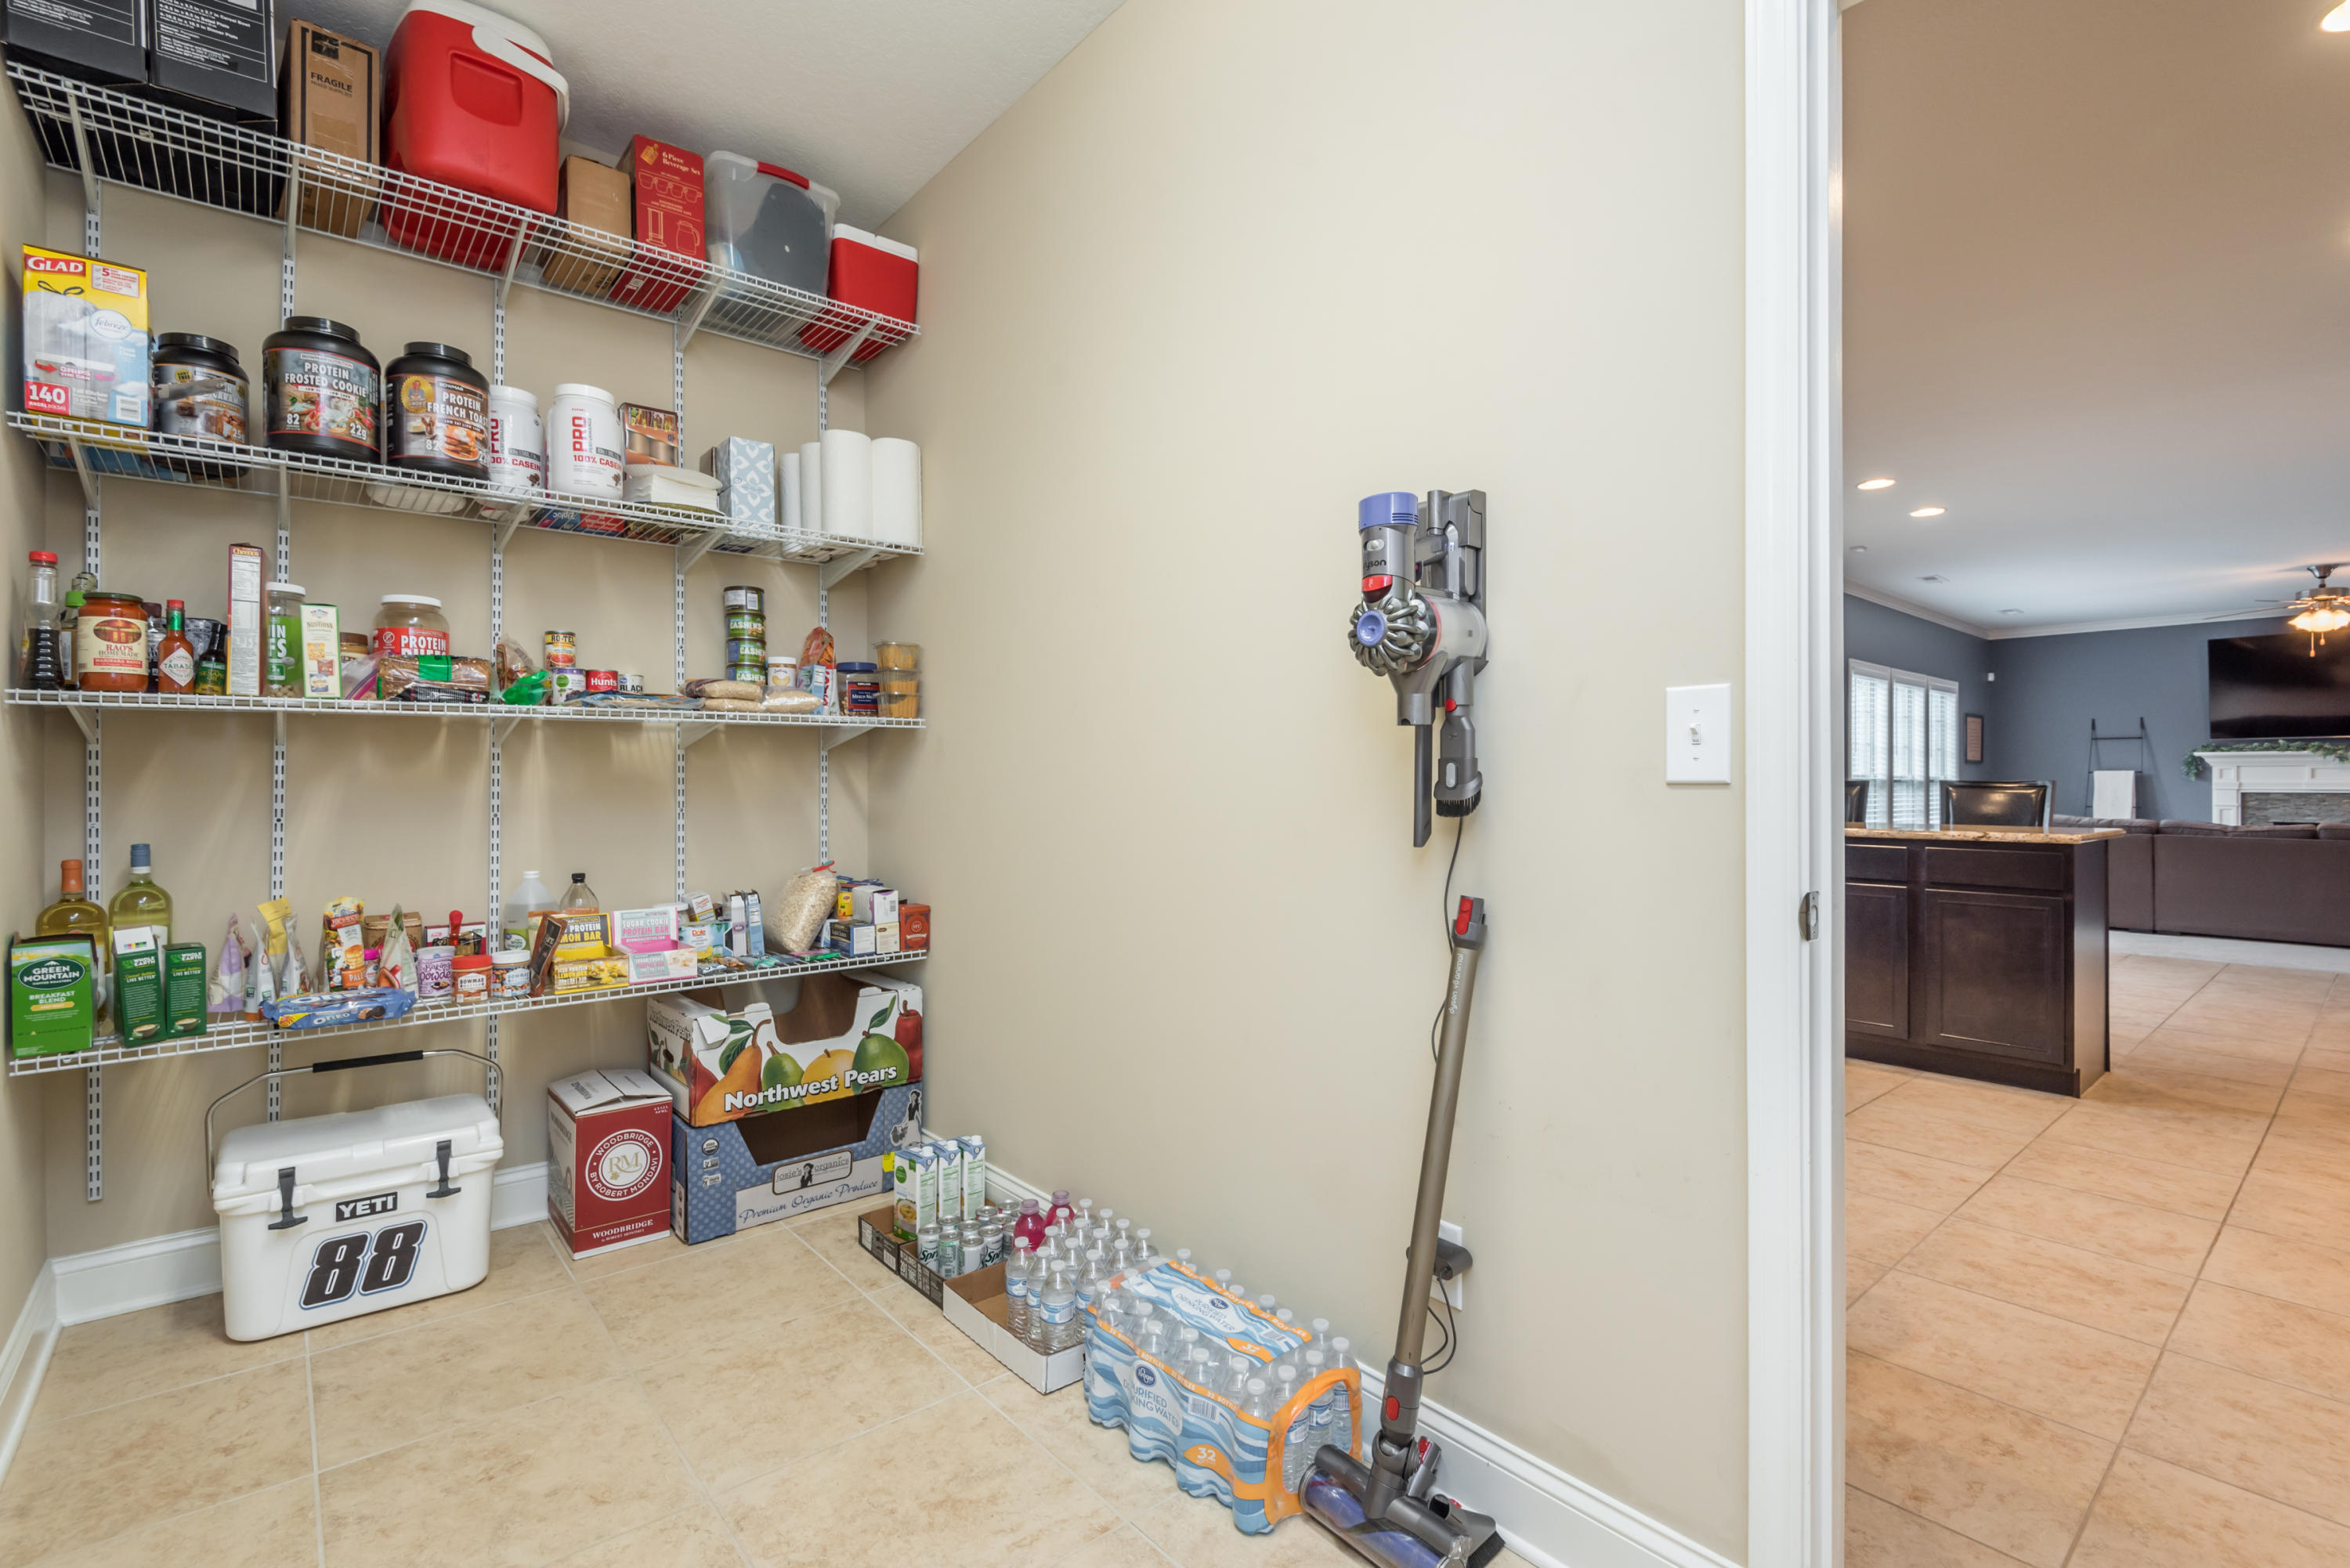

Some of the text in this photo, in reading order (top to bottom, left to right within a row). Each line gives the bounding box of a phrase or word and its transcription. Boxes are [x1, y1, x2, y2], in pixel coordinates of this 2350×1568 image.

[310, 71, 352, 93] FRAGILE
[663, 157, 700, 175] Beverage Set
[668, 154, 684, 164] Piece
[27, 256, 83, 273] GLAD
[101, 268, 110, 276] 5
[95, 316, 128, 331] febreze
[305, 362, 349, 380] PROTEIN
[284, 373, 328, 387] FROSTED
[332, 379, 367, 398] COOKIE
[439, 381, 464, 392] BOWMAR
[29, 385, 67, 404] 140
[443, 392, 481, 411] PROTEIN
[287, 414, 299, 425] 82
[427, 402, 466, 419] FRENCH
[468, 410, 488, 427] TOAST
[349, 423, 367, 440] 22g
[572, 416, 587, 452] PRO
[425, 439, 439, 451] 82
[512, 458, 541, 472] CASEIN
[573, 454, 622, 471] 100% CASEIN
[730, 621, 762, 630] CASHEWS
[107, 644, 133, 652] RAO'S
[401, 635, 446, 651] PROTEIN
[569, 923, 602, 933] PROTEIN
[622, 925, 669, 936] PROTEIN BAR
[623, 917, 668, 928] SUGAR COOKIE
[560, 931, 602, 943] MON BAR
[33, 966, 70, 975] GREEN
[425, 961, 451, 972] Baking
[24, 971, 80, 982] MOUNTAIN
[419, 970, 451, 984] powde
[1448, 991, 1458, 1013] dyson
[1455, 954, 1463, 980] animal
[29, 991, 75, 1000] BREAKFAST
[313, 1012, 350, 1025] OREO
[674, 1019, 691, 1042] Pears
[724, 1066, 897, 1112] Northwest Pears
[595, 1133, 653, 1156] WOODBRIDGE
[608, 1151, 642, 1173] RM
[776, 1156, 850, 1183] josie's organics
[590, 1158, 658, 1197] BY ROBERT MONDAVI
[338, 1195, 396, 1218] YETI
[739, 1180, 878, 1223] Premium Organic Produce
[592, 1219, 653, 1239] WOODBRIDGE
[300, 1220, 427, 1309] 88
[1176, 1293, 1235, 1331] DRINKING WATER
[1195, 1299, 1227, 1319] PURIFIED
[1242, 1343, 1260, 1353] 32
[1141, 1353, 1165, 1370] BOTTLES
[1137, 1368, 1154, 1385] Kroger
[1134, 1386, 1167, 1408] URIFIED
[1197, 1447, 1216, 1461] 32
